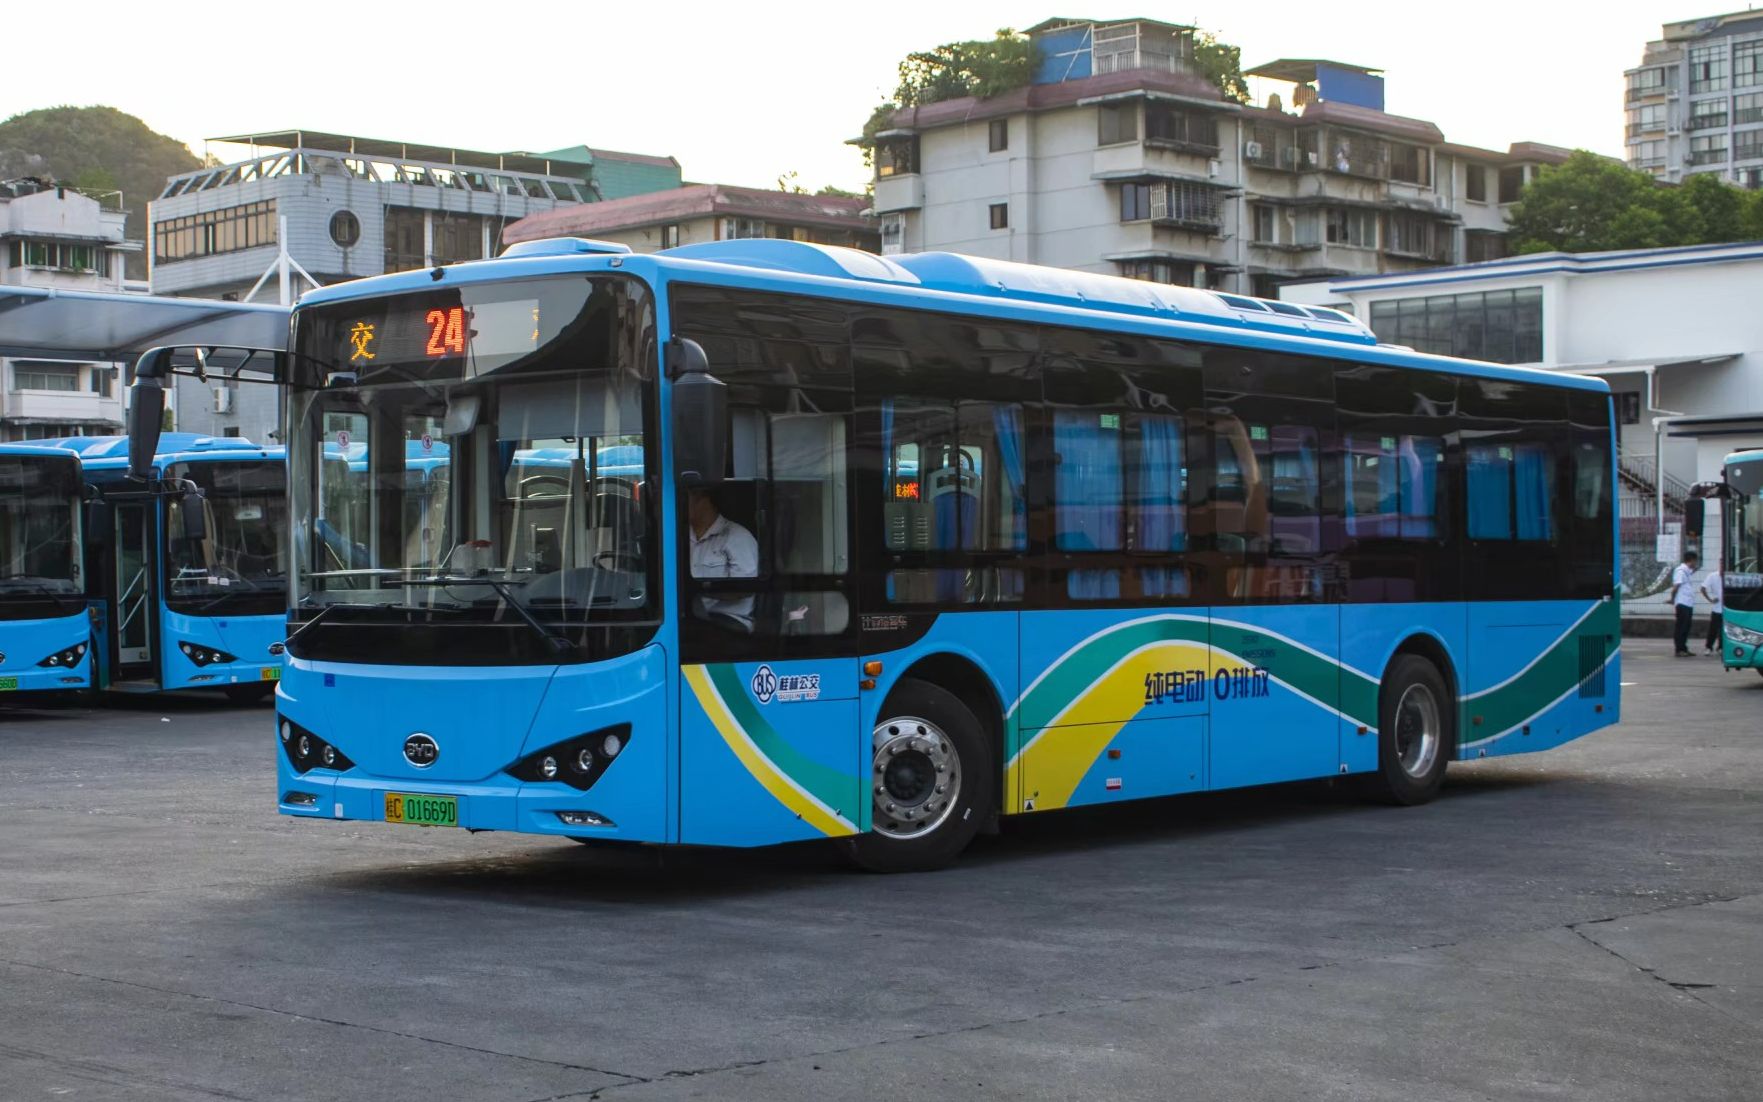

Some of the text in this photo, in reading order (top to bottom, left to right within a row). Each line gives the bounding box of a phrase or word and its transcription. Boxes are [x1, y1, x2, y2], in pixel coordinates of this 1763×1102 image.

[351, 322, 376, 361] 交
[426, 307, 464, 355] 24
[1144, 669, 1206, 706] 纯电动
[406, 742, 434, 757] BYD
